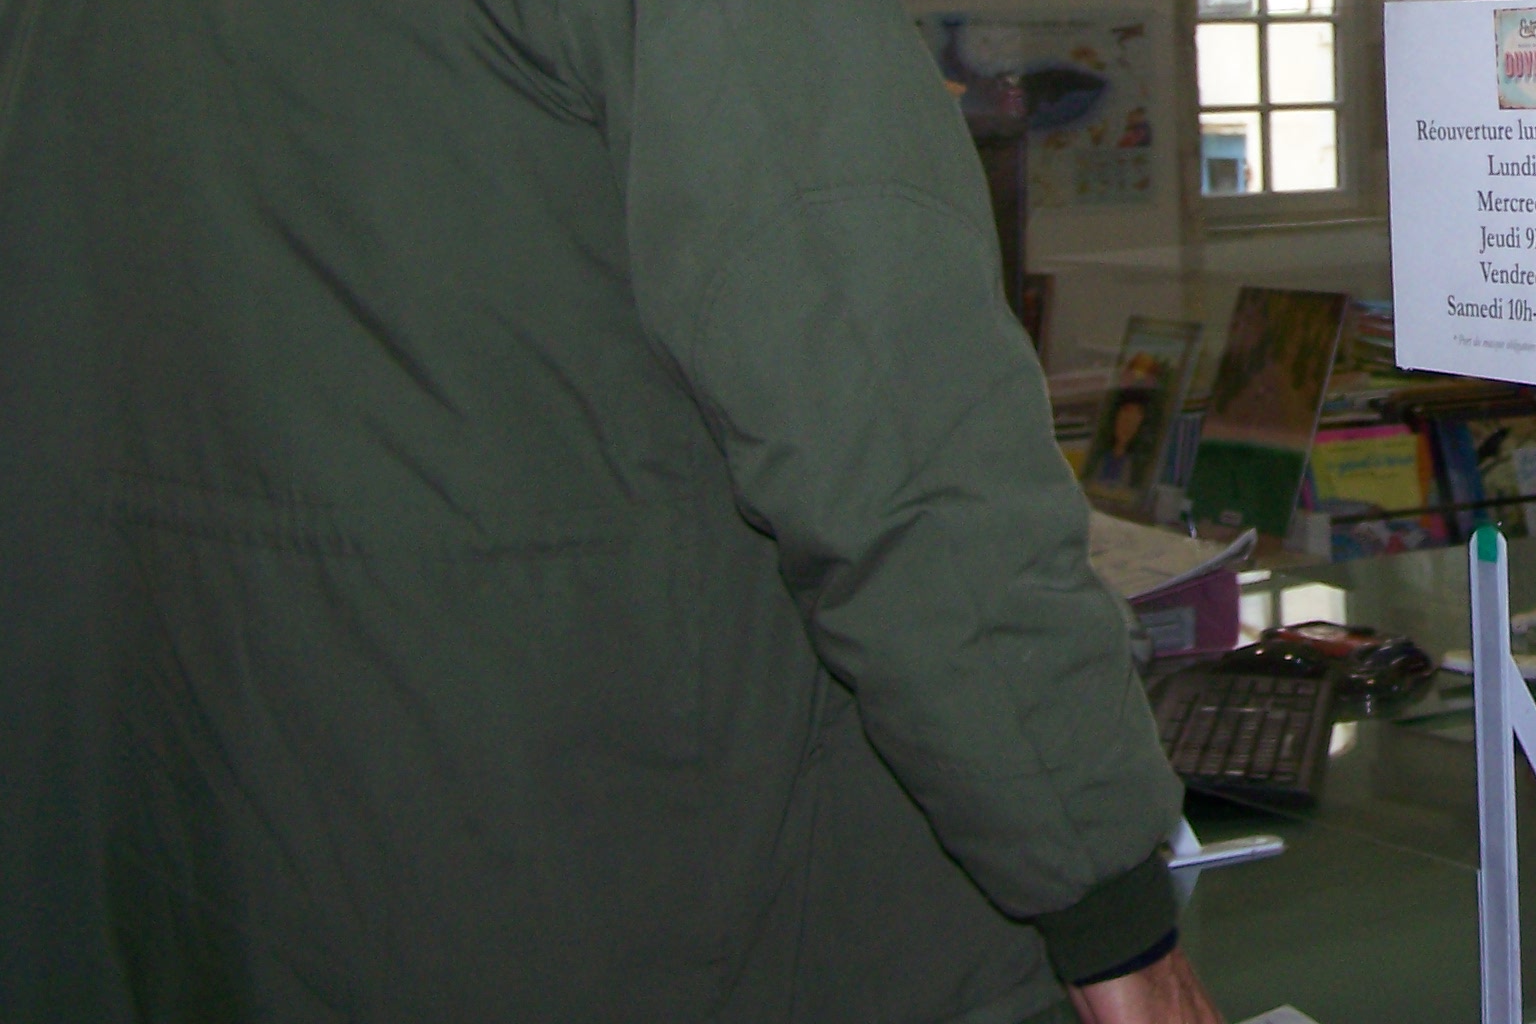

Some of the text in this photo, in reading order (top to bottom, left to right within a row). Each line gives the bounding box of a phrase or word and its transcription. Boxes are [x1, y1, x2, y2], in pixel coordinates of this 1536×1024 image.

[1416, 119, 1514, 141] Réouverture
[1487, 154, 1536, 177] Lundi
[1479, 225, 1521, 254] Jeudi
[1447, 294, 1503, 320] Samedi
